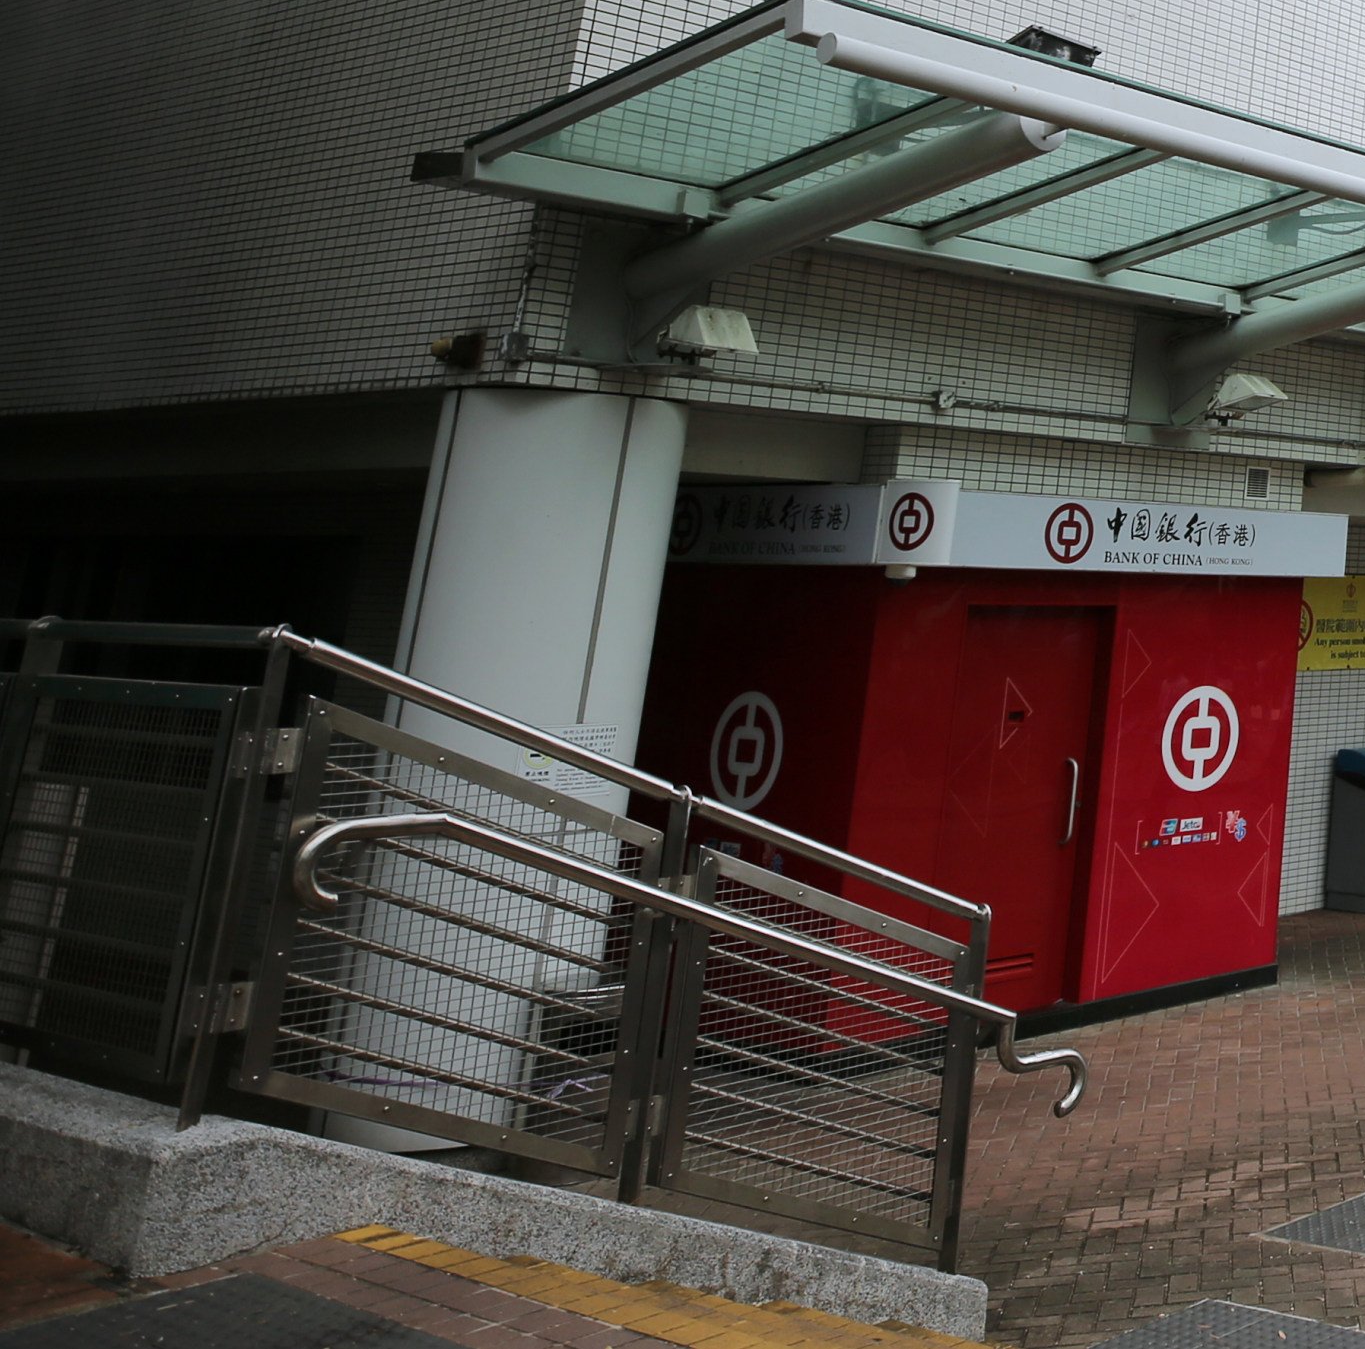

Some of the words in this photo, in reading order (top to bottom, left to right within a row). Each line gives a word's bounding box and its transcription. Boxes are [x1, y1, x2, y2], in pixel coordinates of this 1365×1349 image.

[1107, 507, 1256, 547] 中國銀行(香港)
[758, 541, 796, 556] CHINA
[1103, 551, 1140, 565] BANK
[1142, 551, 1160, 566] OF
[1162, 552, 1203, 567] CHINA
[1205, 556, 1229, 566] (HONG
[1230, 556, 1254, 567] KONG)
[1315, 638, 1327, 646] Any
[1329, 638, 1351, 647] person
[1330, 650, 1336, 659] is
[1337, 650, 1359, 660] subject
